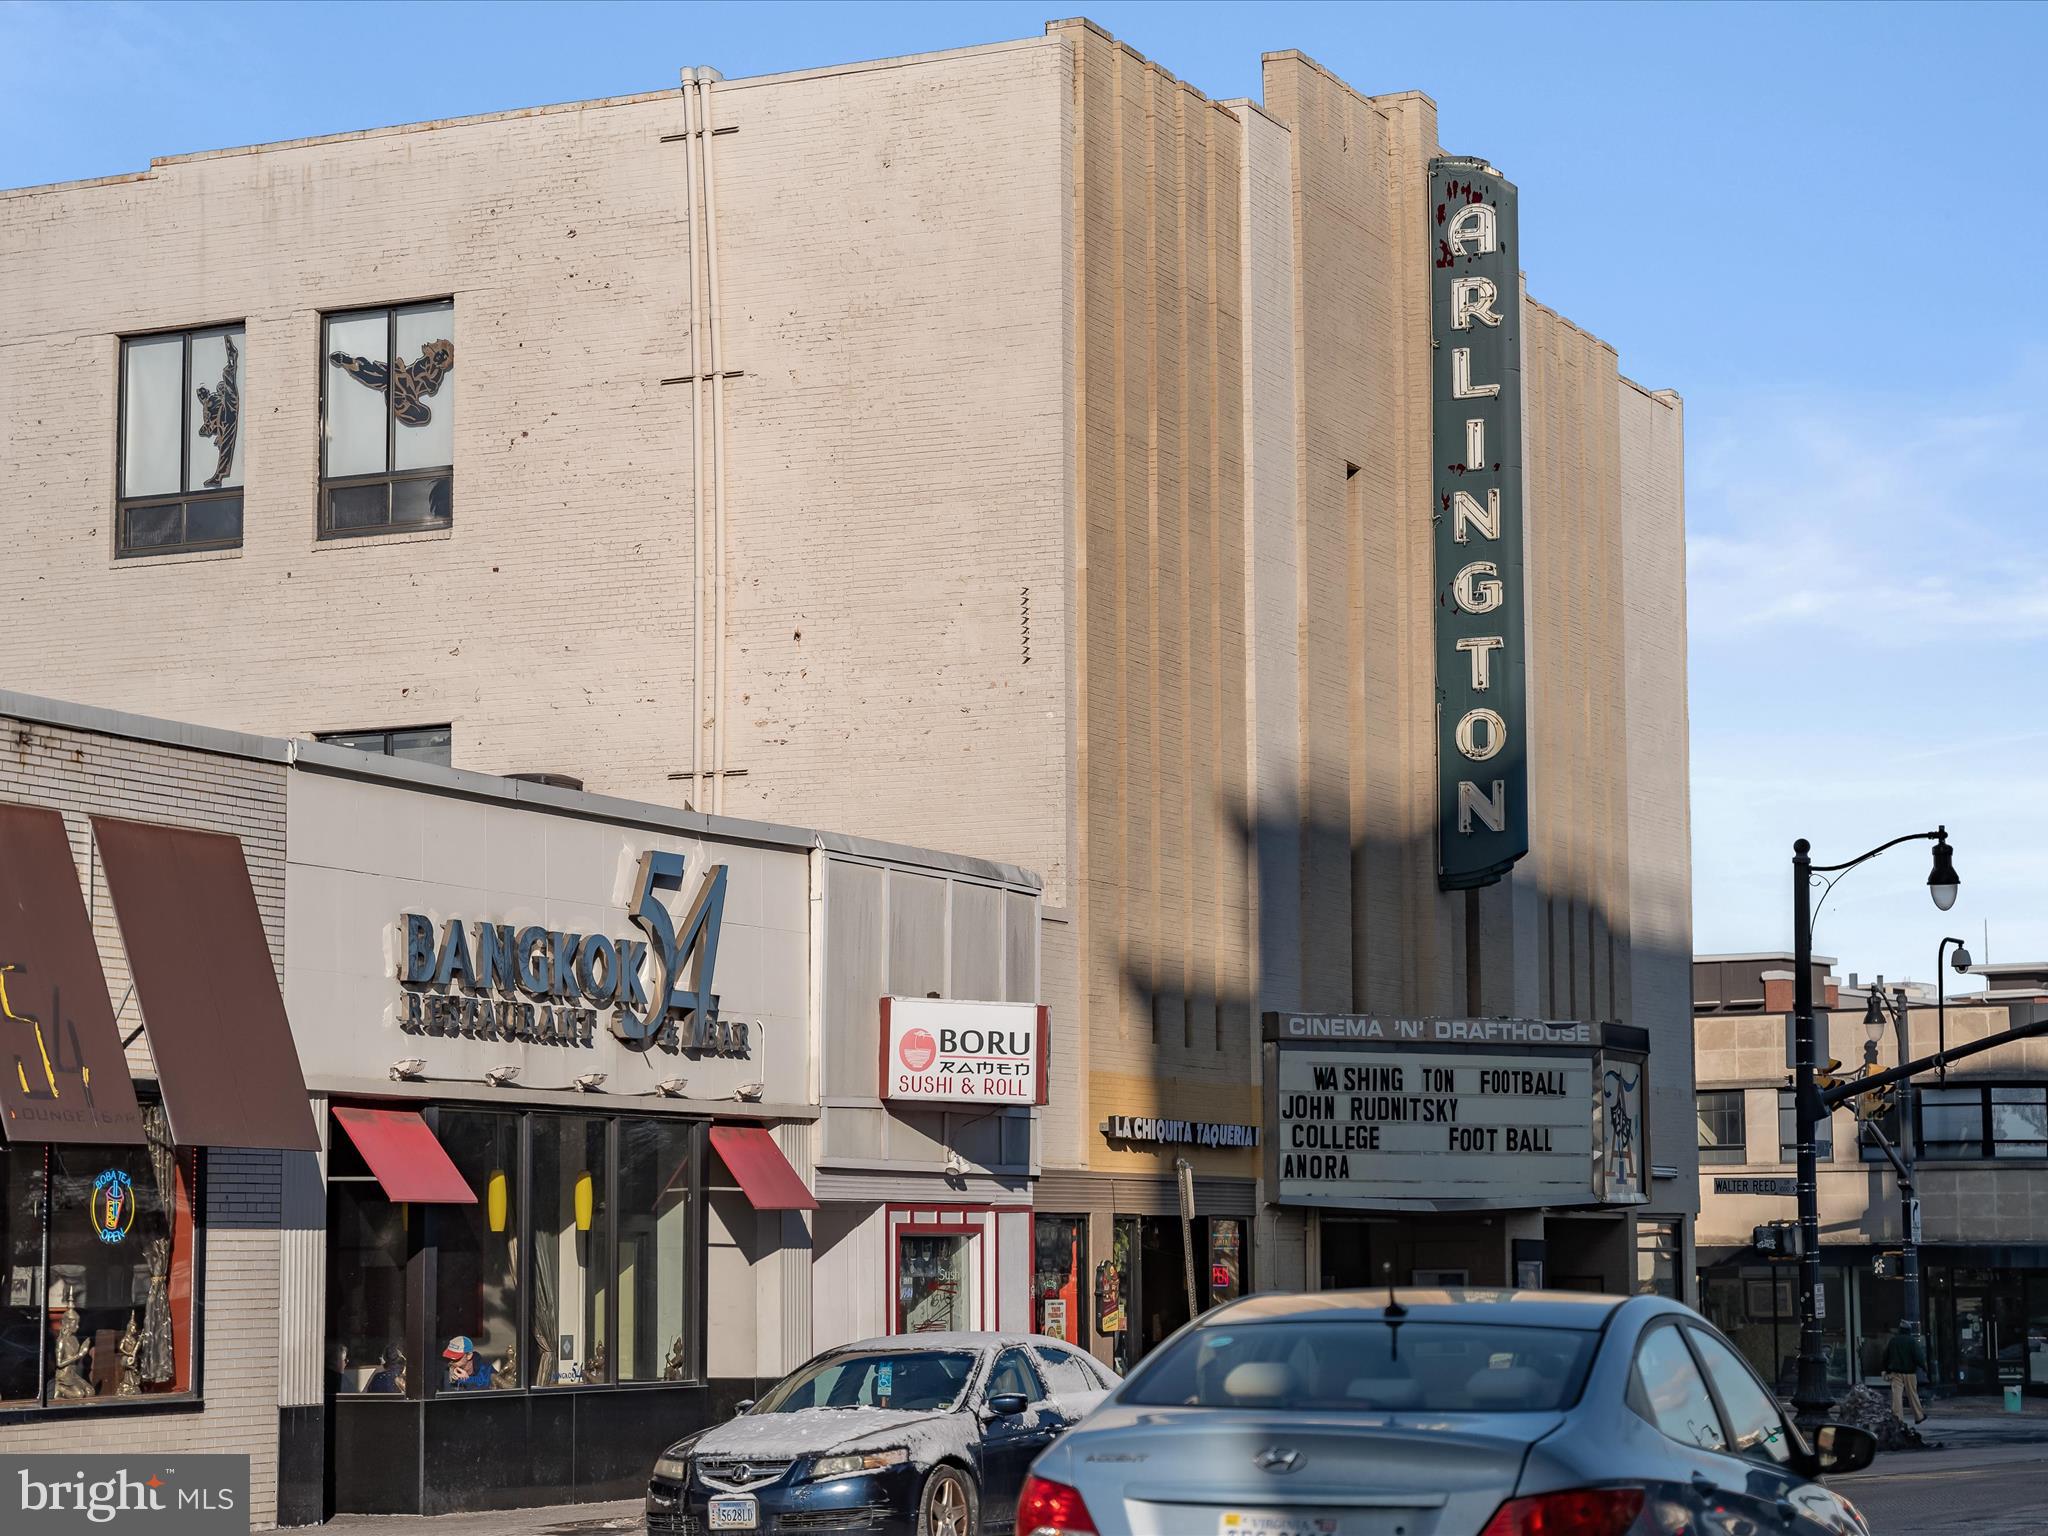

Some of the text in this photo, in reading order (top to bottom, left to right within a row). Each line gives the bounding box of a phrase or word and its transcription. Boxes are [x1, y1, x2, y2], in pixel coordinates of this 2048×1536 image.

[1446, 202, 1507, 836] ARLINGTON
[400, 850, 728, 1049] BANGKOK 54
[400, 991, 751, 1053] RESTAURANT & BAR
[1289, 1017, 1384, 1037] CINEMA
[1435, 1021, 1590, 1042] DRAFTHOUSE
[939, 1029, 1030, 1056] BORU
[939, 1061, 1030, 1076] RAMEN
[899, 1075, 1027, 1097] SUSHI & ROLL
[1480, 1070, 1566, 1096] FOOTBALL
[1282, 1095, 1458, 1122] JOHN RUDNITSKY
[1115, 1116, 1132, 1138] LA
[1133, 1117, 1192, 1143] CHIQUITA
[1196, 1123, 1253, 1148] TAQUERIA
[1292, 1124, 1380, 1150] COLLEGE
[95, 1170, 132, 1189] BOBA TEA
[1284, 1154, 1350, 1179] ANORA
[1715, 1180, 1748, 1192] WALTER
[1753, 1180, 1777, 1192] REED
[101, 1228, 125, 1242] OPEN
